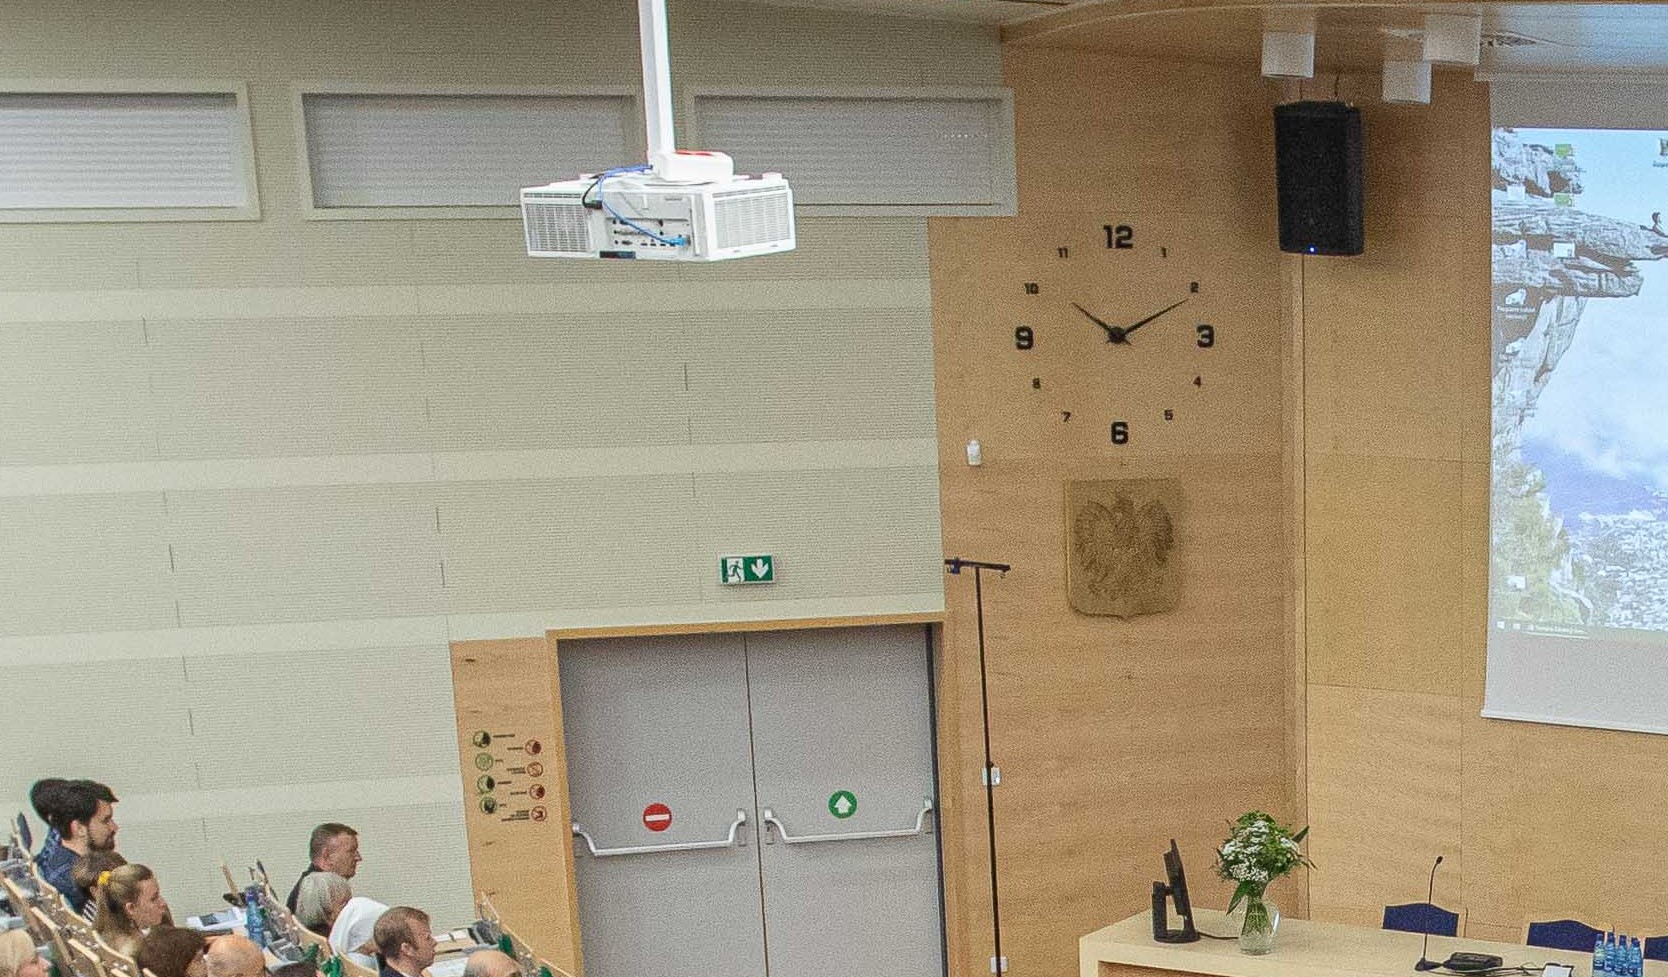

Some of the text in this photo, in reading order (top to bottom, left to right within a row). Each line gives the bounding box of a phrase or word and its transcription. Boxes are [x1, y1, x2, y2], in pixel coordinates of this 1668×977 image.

[1103, 224, 1134, 249] 12
[1057, 247, 1069, 258] 11
[1161, 247, 1168, 258] 1
[1015, 325, 1034, 350] 9
[1196, 324, 1215, 348] 3
[1193, 376, 1202, 388] 4
[1062, 411, 1071, 423] 7
[1164, 409, 1174, 421] 5
[1110, 421, 1129, 445] 6
